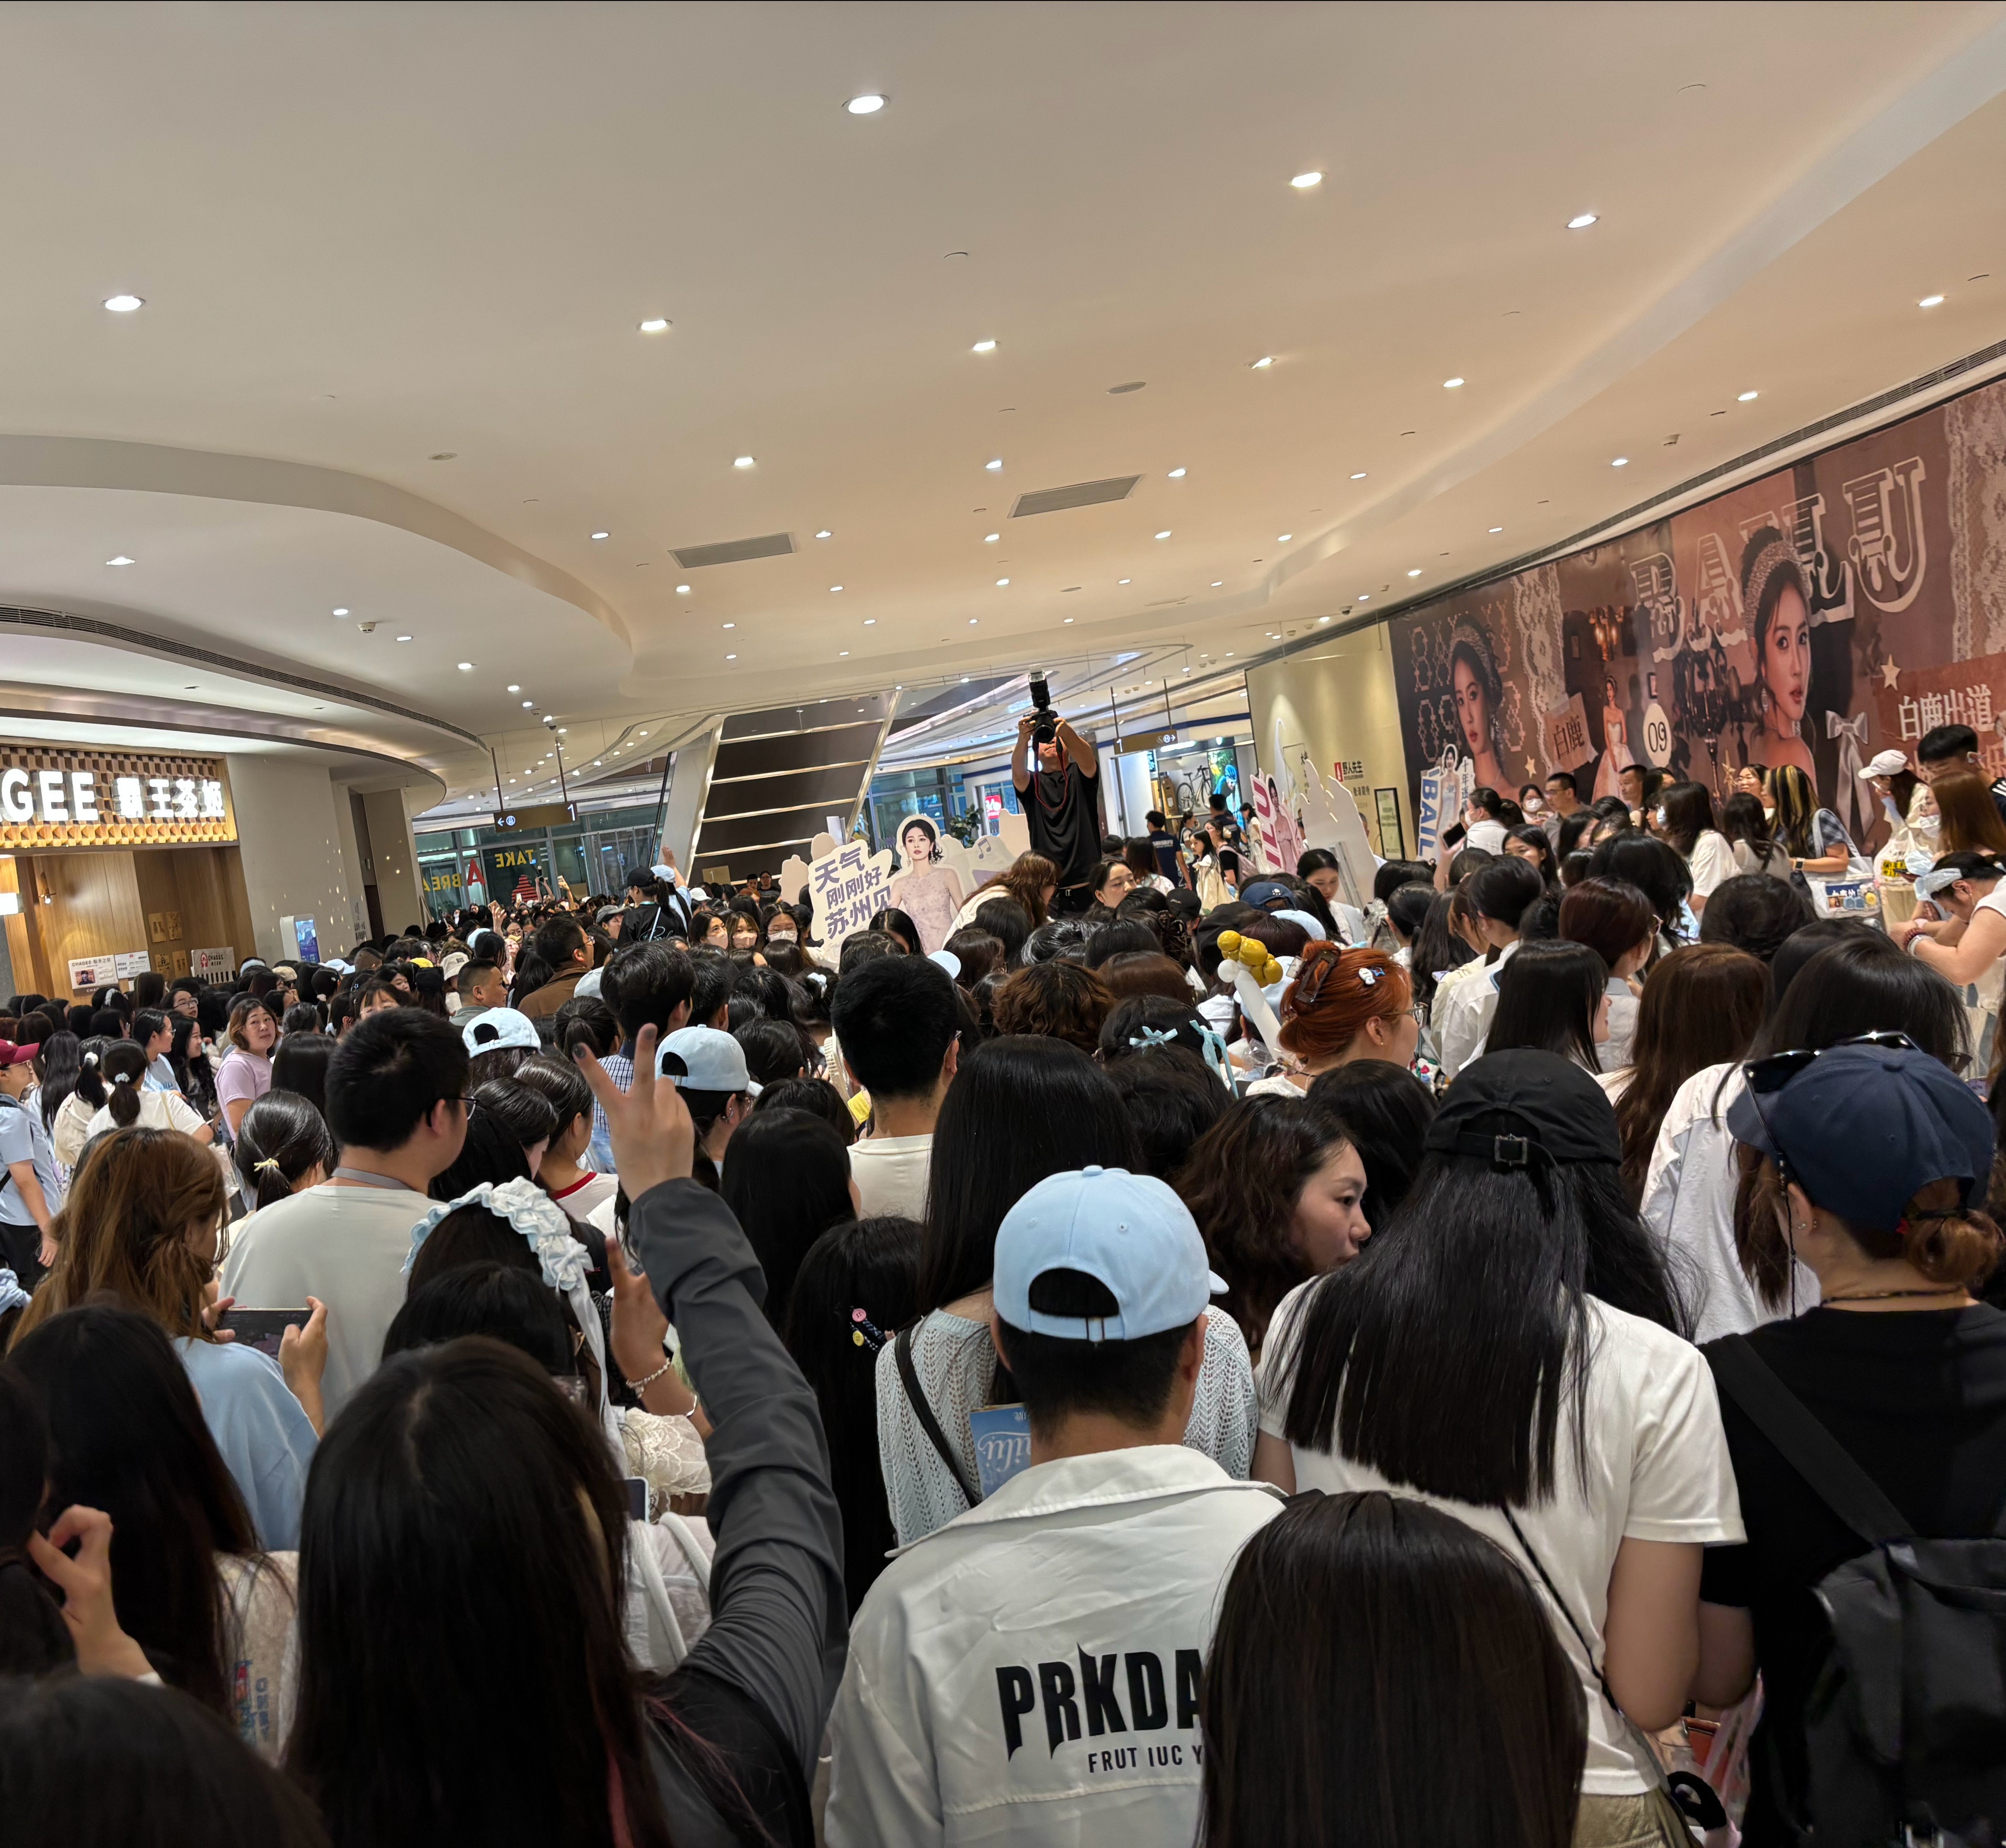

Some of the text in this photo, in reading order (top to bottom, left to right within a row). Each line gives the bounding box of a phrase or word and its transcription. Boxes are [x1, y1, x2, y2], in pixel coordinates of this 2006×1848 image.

[1630, 456, 1926, 663] BALU
[1898, 684, 1995, 741] 白鹿出道
[1116, 738, 1123, 753] 1
[1553, 715, 1585, 760] 白鹿
[1648, 721, 1667, 753] 09
[1, 769, 99, 822] GEE
[568, 804, 575, 821] 1
[815, 846, 865, 894] 天气
[826, 866, 882, 910] 刚刚好
[825, 885, 891, 940] 苏州见
[978, 1432, 1031, 1473] ilu
[995, 1642, 1204, 1762] PRKDA
[1088, 1744, 1203, 1773] FRUT IUC Y
